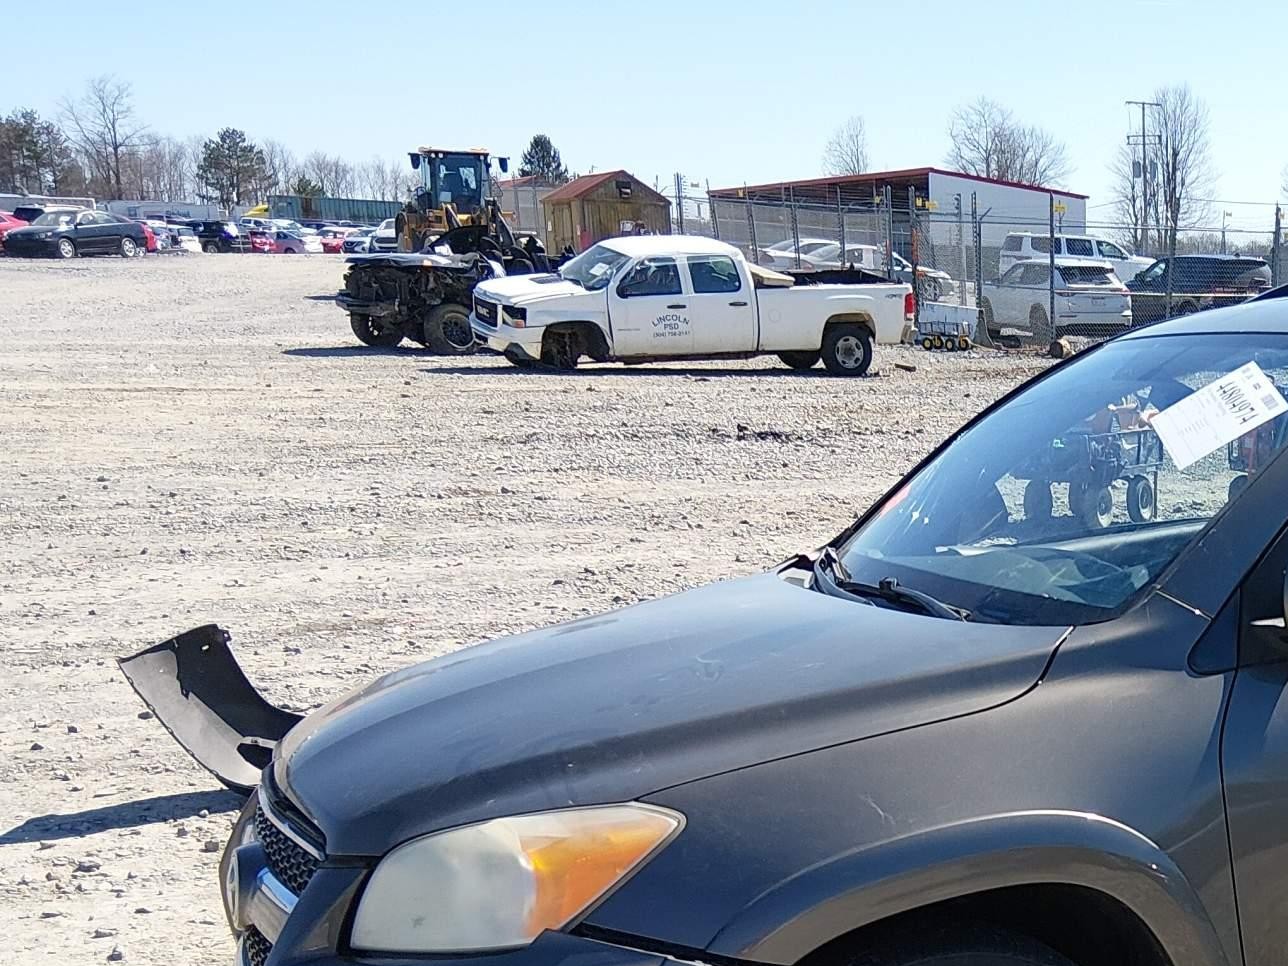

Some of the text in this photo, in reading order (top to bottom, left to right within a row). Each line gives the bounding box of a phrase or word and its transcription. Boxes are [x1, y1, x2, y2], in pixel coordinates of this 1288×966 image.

[651, 314, 690, 327] LINCOLN
[663, 323, 679, 331] PSD
[1216, 380, 1259, 426] 44804974
